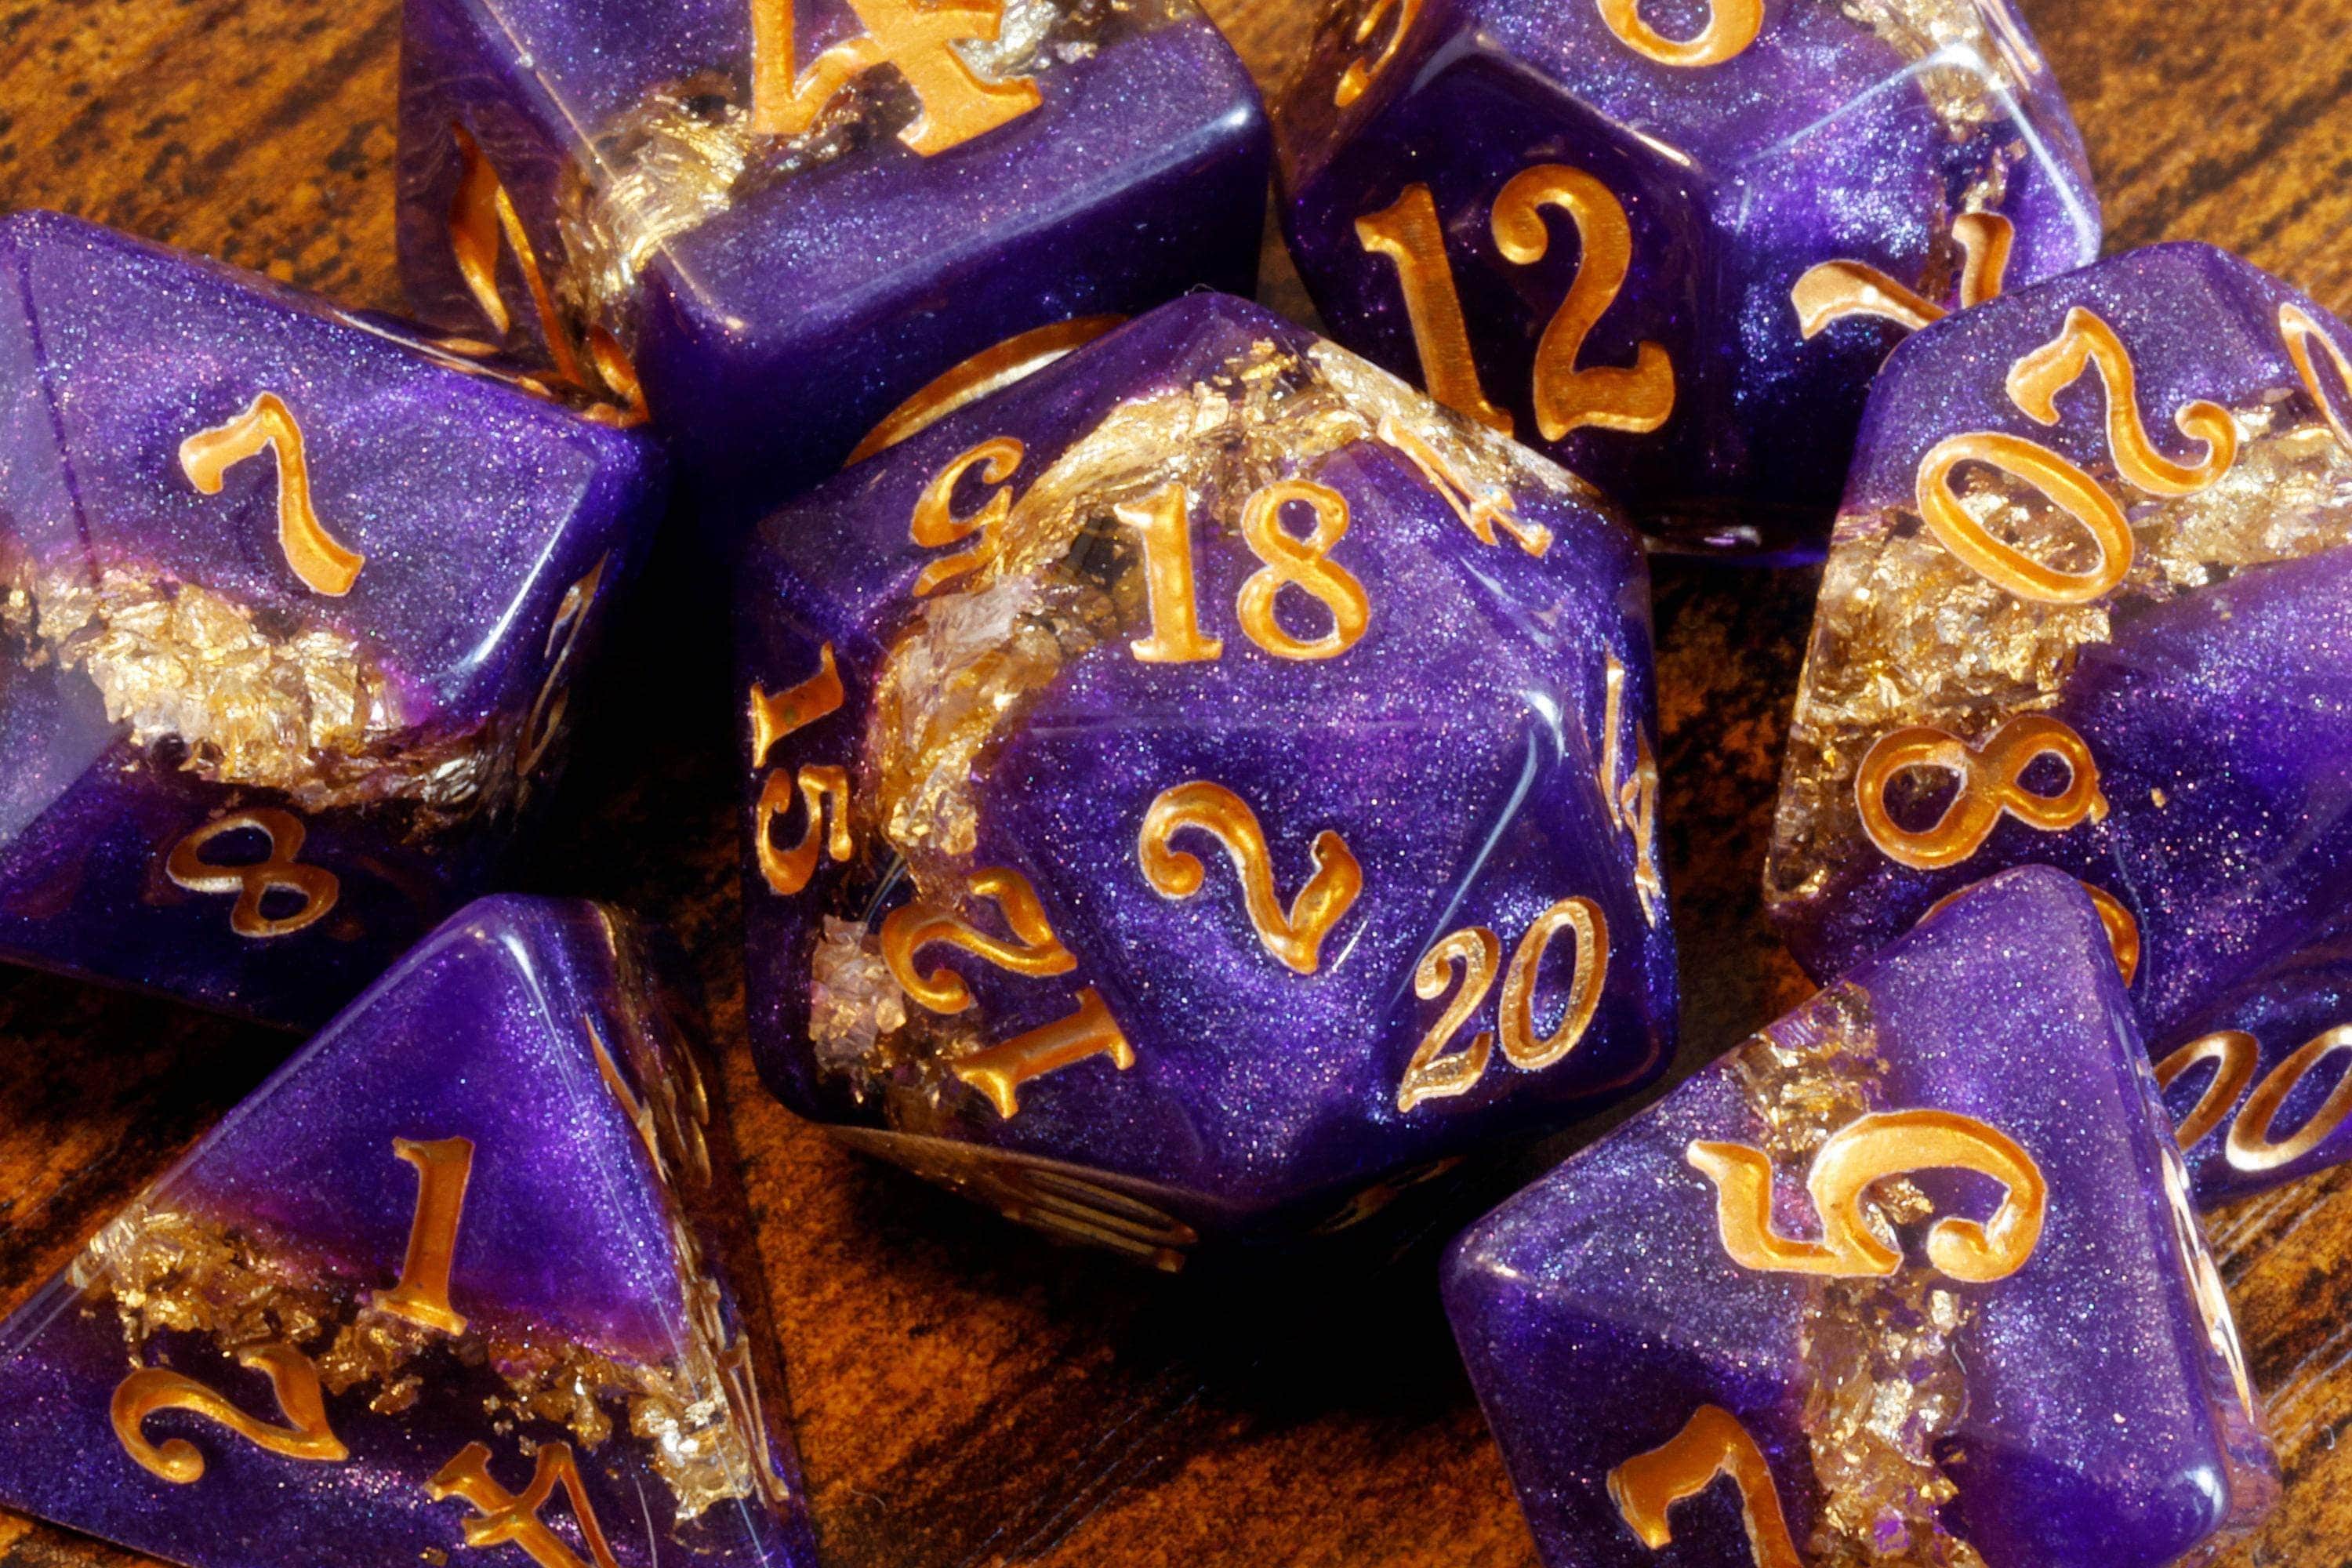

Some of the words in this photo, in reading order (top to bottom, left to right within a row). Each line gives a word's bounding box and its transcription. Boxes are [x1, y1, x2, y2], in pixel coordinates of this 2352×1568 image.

[751, 0, 1044, 157] 4
[1355, 163, 1675, 441] 12
[180, 390, 365, 597] 7
[1113, 479, 1370, 663] 18
[747, 641, 854, 895] 15
[166, 808, 339, 938] 8
[1138, 780, 1363, 975] 2
[880, 866, 1135, 1120] 12
[1395, 896, 1610, 1113] 20
[372, 1136, 475, 1337] 1
[1686, 1109, 2047, 1283] 5
[110, 1342, 350, 1485] 2
[423, 1441, 619, 1568] 4
